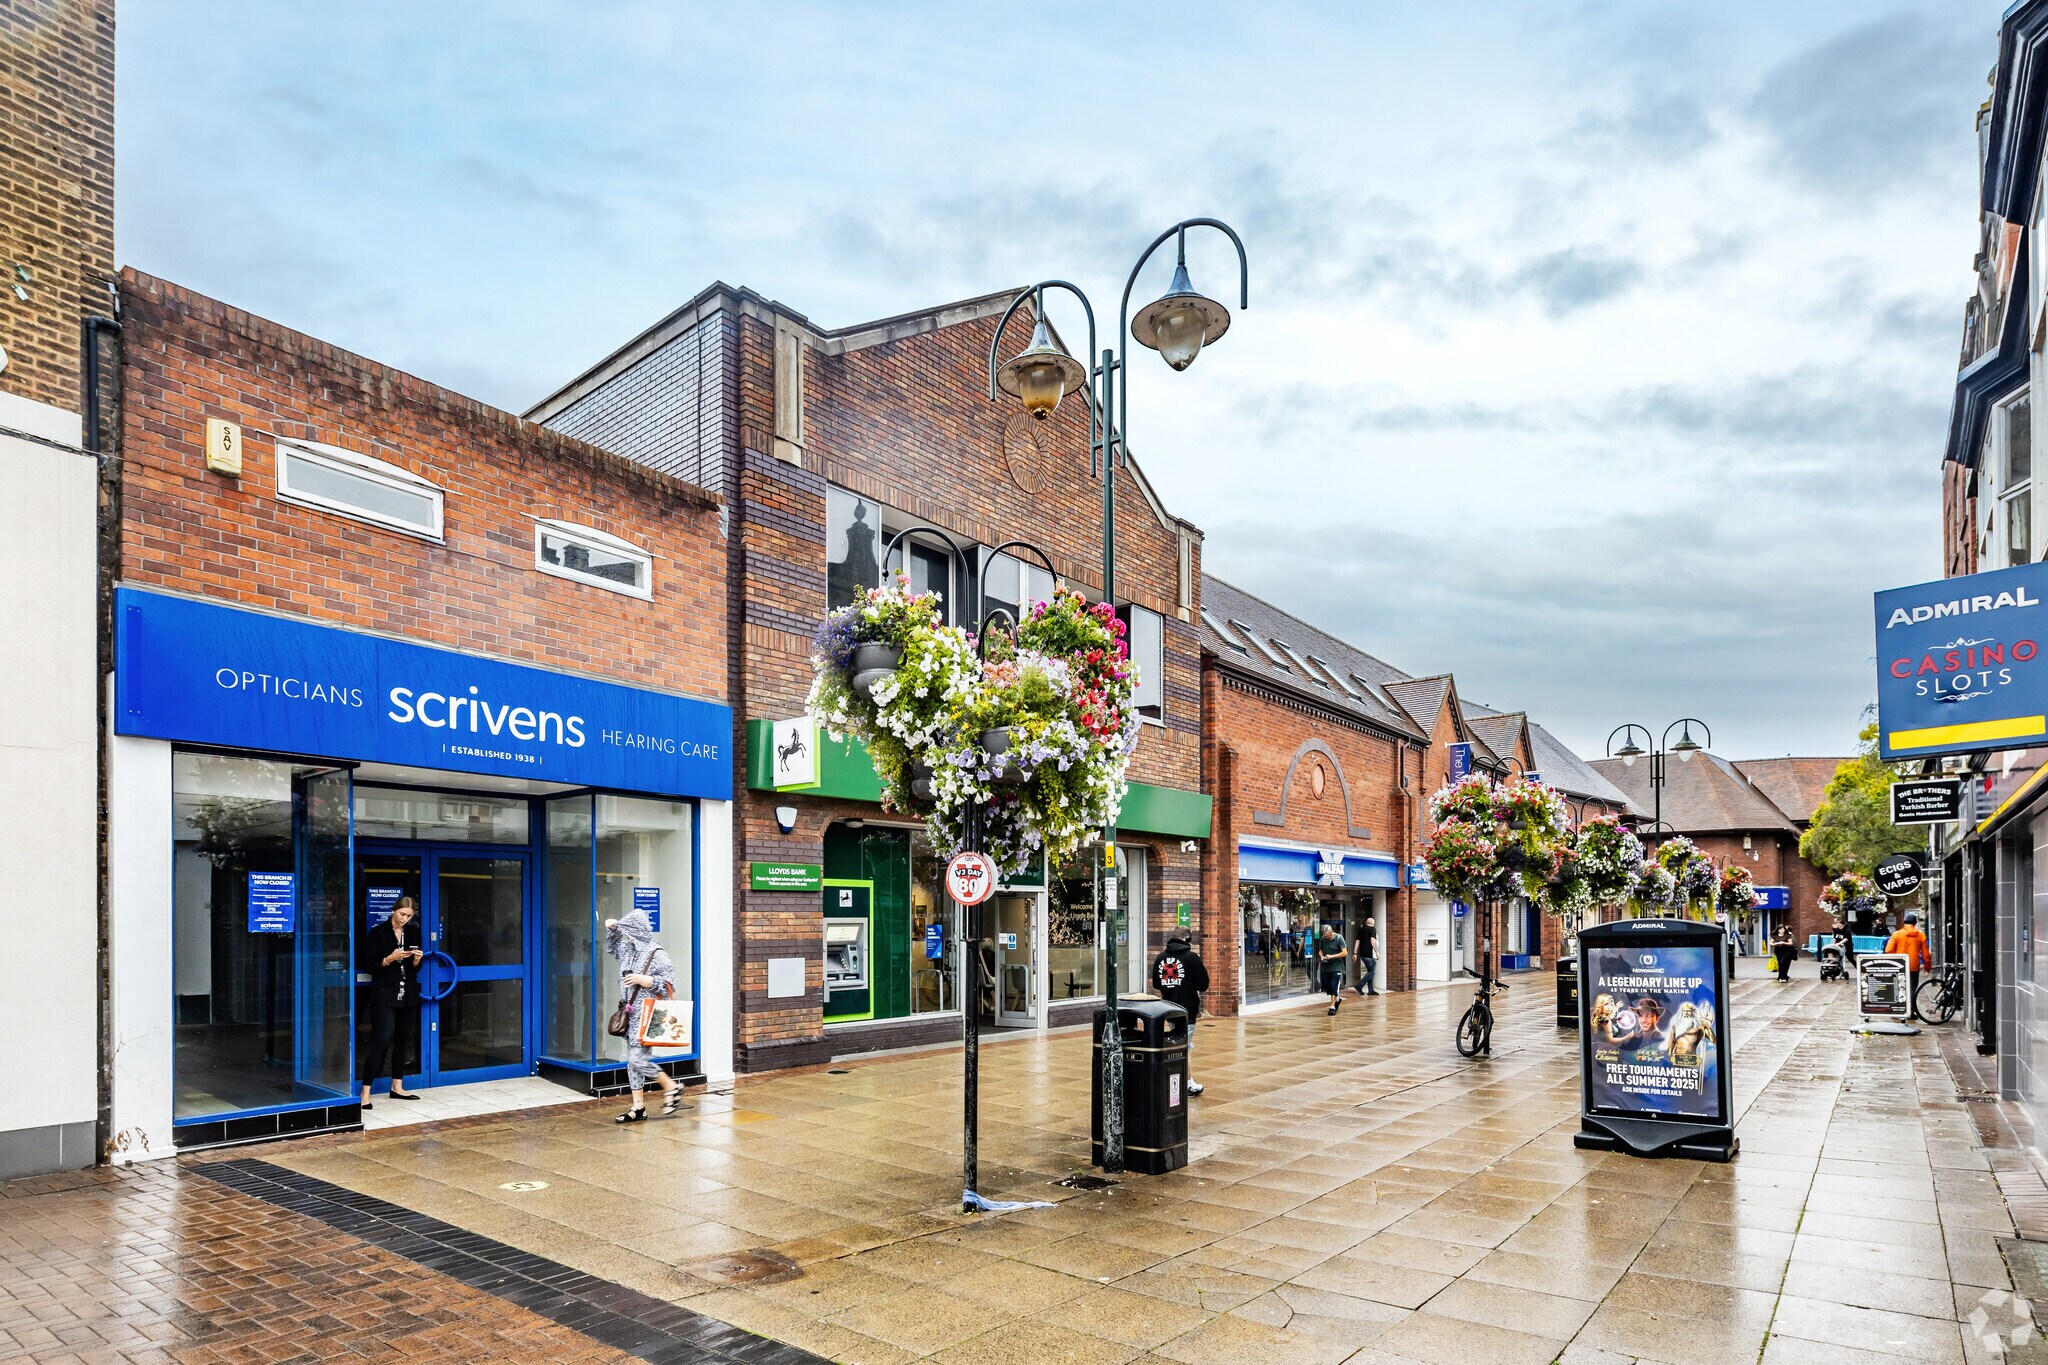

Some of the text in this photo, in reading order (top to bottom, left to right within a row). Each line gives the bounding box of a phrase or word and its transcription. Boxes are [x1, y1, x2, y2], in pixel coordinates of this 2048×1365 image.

[1885, 586, 2039, 629] ADMIRAL
[1890, 639, 2038, 679] CASINO
[215, 668, 363, 708] OPTICIANS
[1916, 668, 2012, 696] SLOTS
[388, 685, 586, 748] scrivens
[602, 729, 718, 760] HEARING CARE
[451, 746, 535, 763] ESTABLISHED 1938
[1454, 747, 1466, 768] The
[1897, 787, 1951, 799] THE BRTHERS
[1907, 795, 1943, 804] Traditional
[1900, 803, 1925, 811] Turkish
[1107, 855, 1113, 864] 3
[768, 867, 806, 876] LLOYDS BANK
[967, 869, 983, 877] DAY
[1319, 862, 1345, 876] HALIFAX
[1878, 861, 1912, 876] ECIGS
[957, 877, 980, 894] 80
[1883, 875, 1919, 891] VAPES
[1598, 976, 1703, 989] A LEGENDARY LINE UP
[1606, 1063, 1699, 1079] FREE TOURNAMENTS
[1606, 1073, 1699, 1090] ALL SUMMER 2025!
[1661, 1089, 1683, 1097] DETAILS
